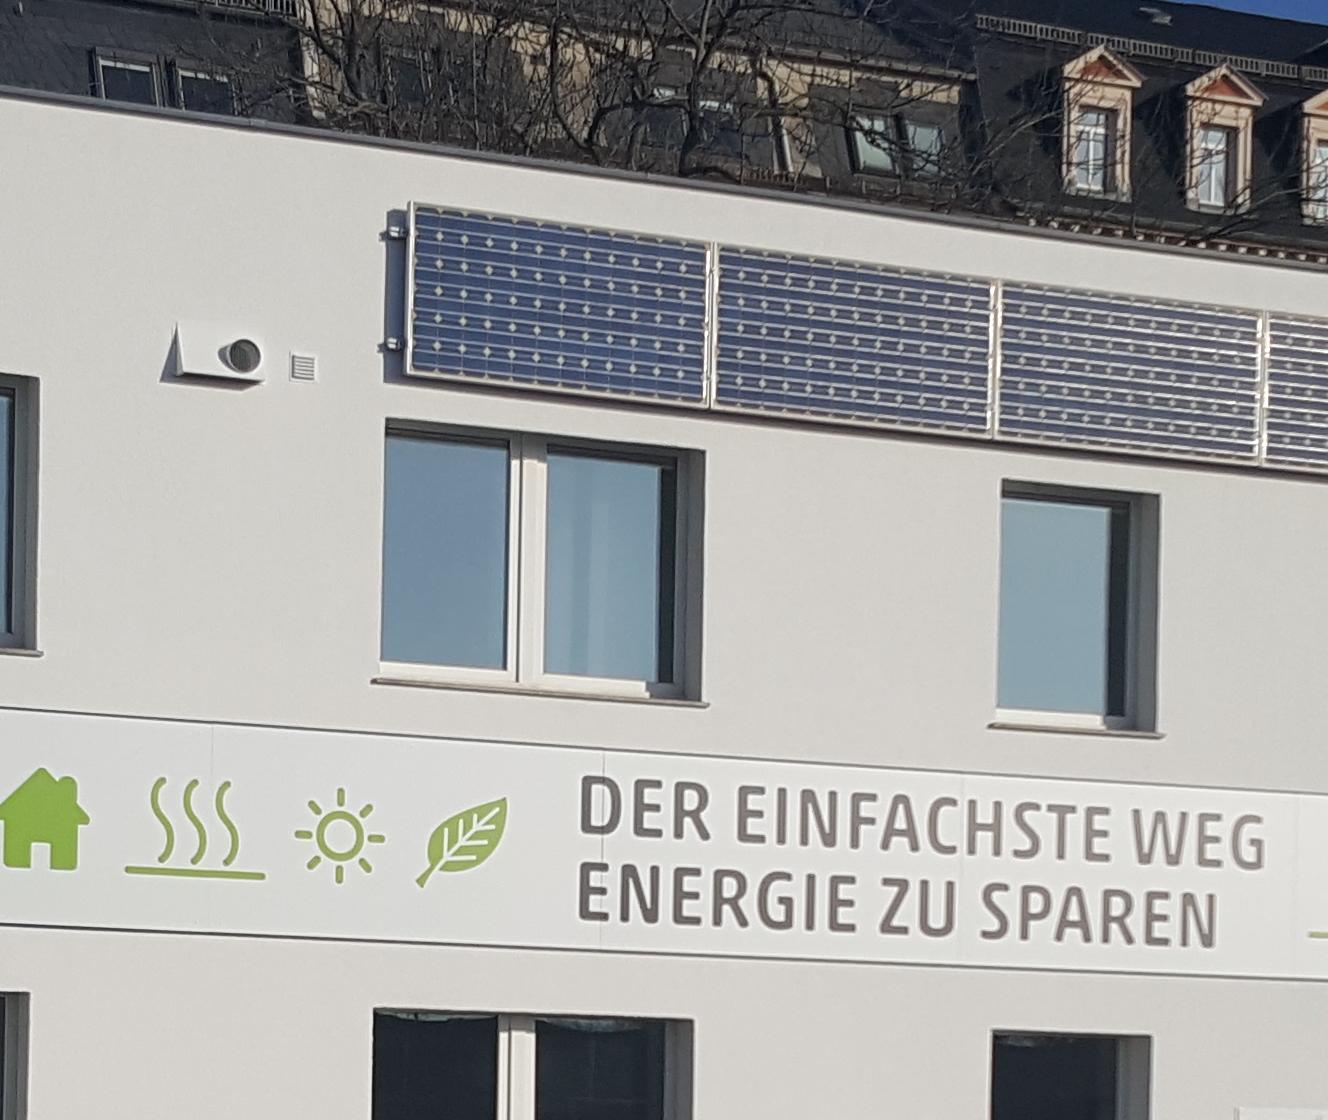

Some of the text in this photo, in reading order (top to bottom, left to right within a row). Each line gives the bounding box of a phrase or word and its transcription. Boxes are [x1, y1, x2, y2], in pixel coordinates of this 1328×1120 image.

[579, 774, 1264, 871] DER EINFACHSTE WEG
[577, 860, 1217, 950] ENERGIE ZU SPAREN
